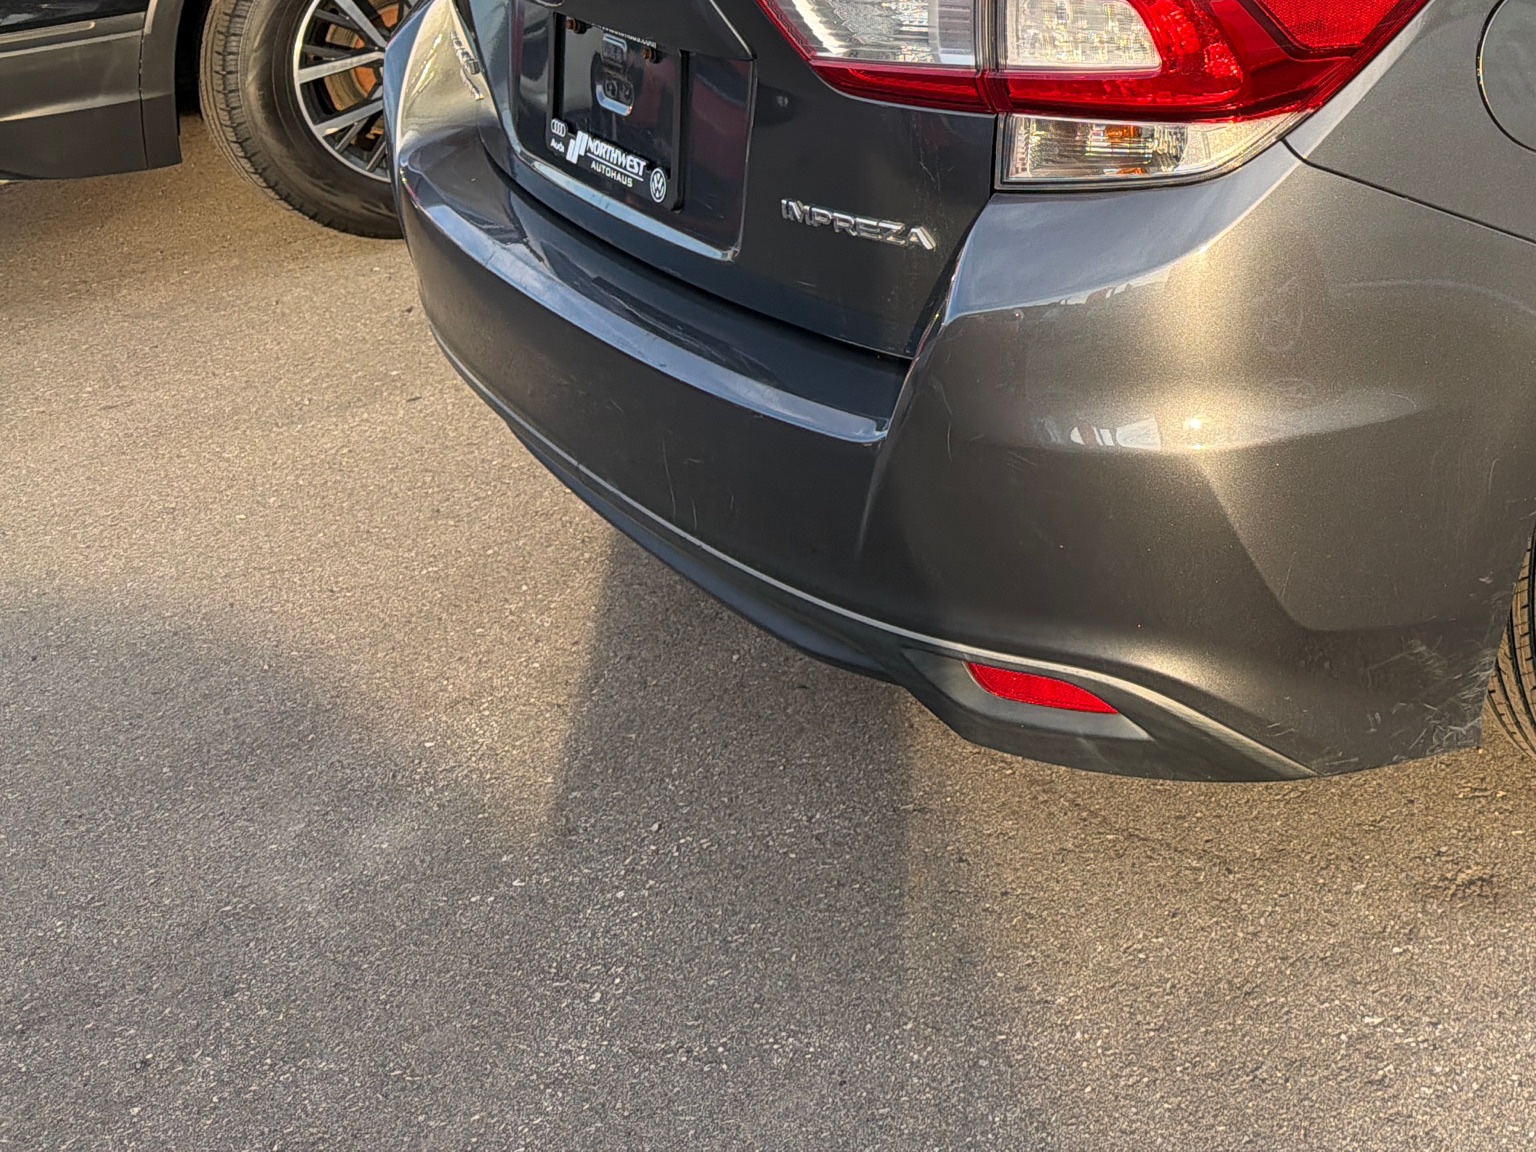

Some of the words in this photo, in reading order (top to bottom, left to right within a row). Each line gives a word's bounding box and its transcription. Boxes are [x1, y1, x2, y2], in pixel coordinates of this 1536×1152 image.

[550, 138, 565, 153] Audi
[587, 136, 647, 176] NORTHWEST
[591, 160, 633, 187] AUTOHAUS
[650, 169, 666, 201] VW
[781, 198, 937, 250] IMPREZA
